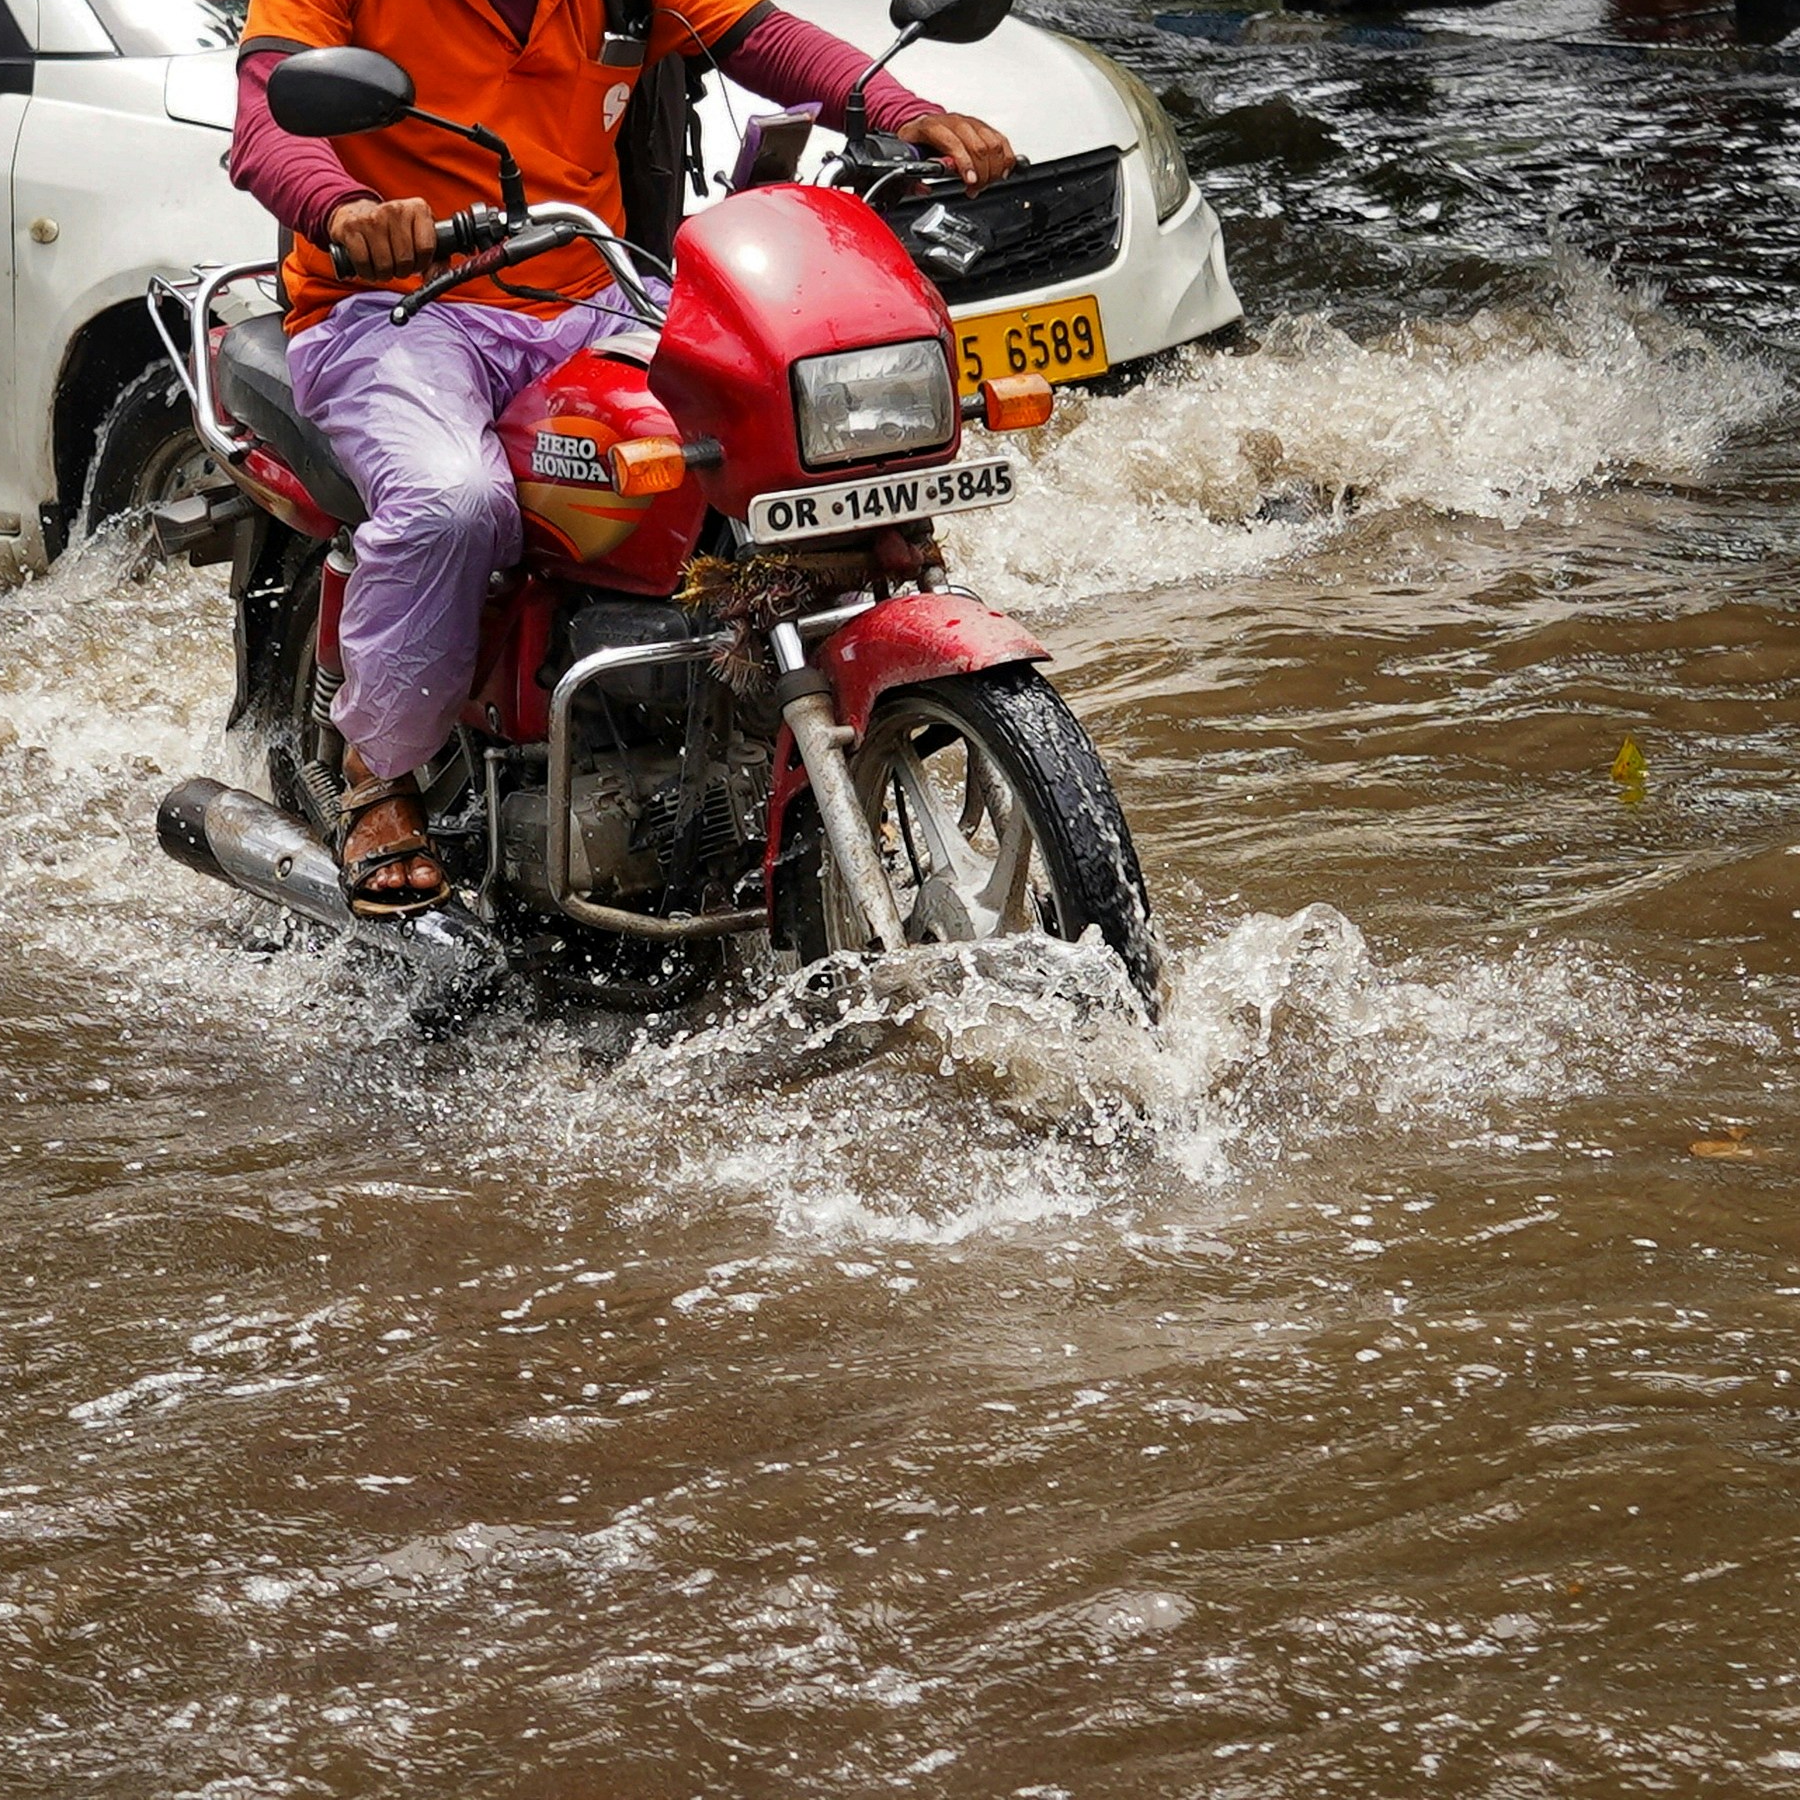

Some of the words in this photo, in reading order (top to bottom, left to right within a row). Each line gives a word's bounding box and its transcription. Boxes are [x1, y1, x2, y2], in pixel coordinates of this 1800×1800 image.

[1004, 314, 1095, 373] 6589
[531, 451, 609, 484] HONDA
[535, 431, 597, 458] HERO
[766, 498, 820, 532] OR
[845, 481, 919, 521] 14W
[937, 464, 1013, 505] 5845
